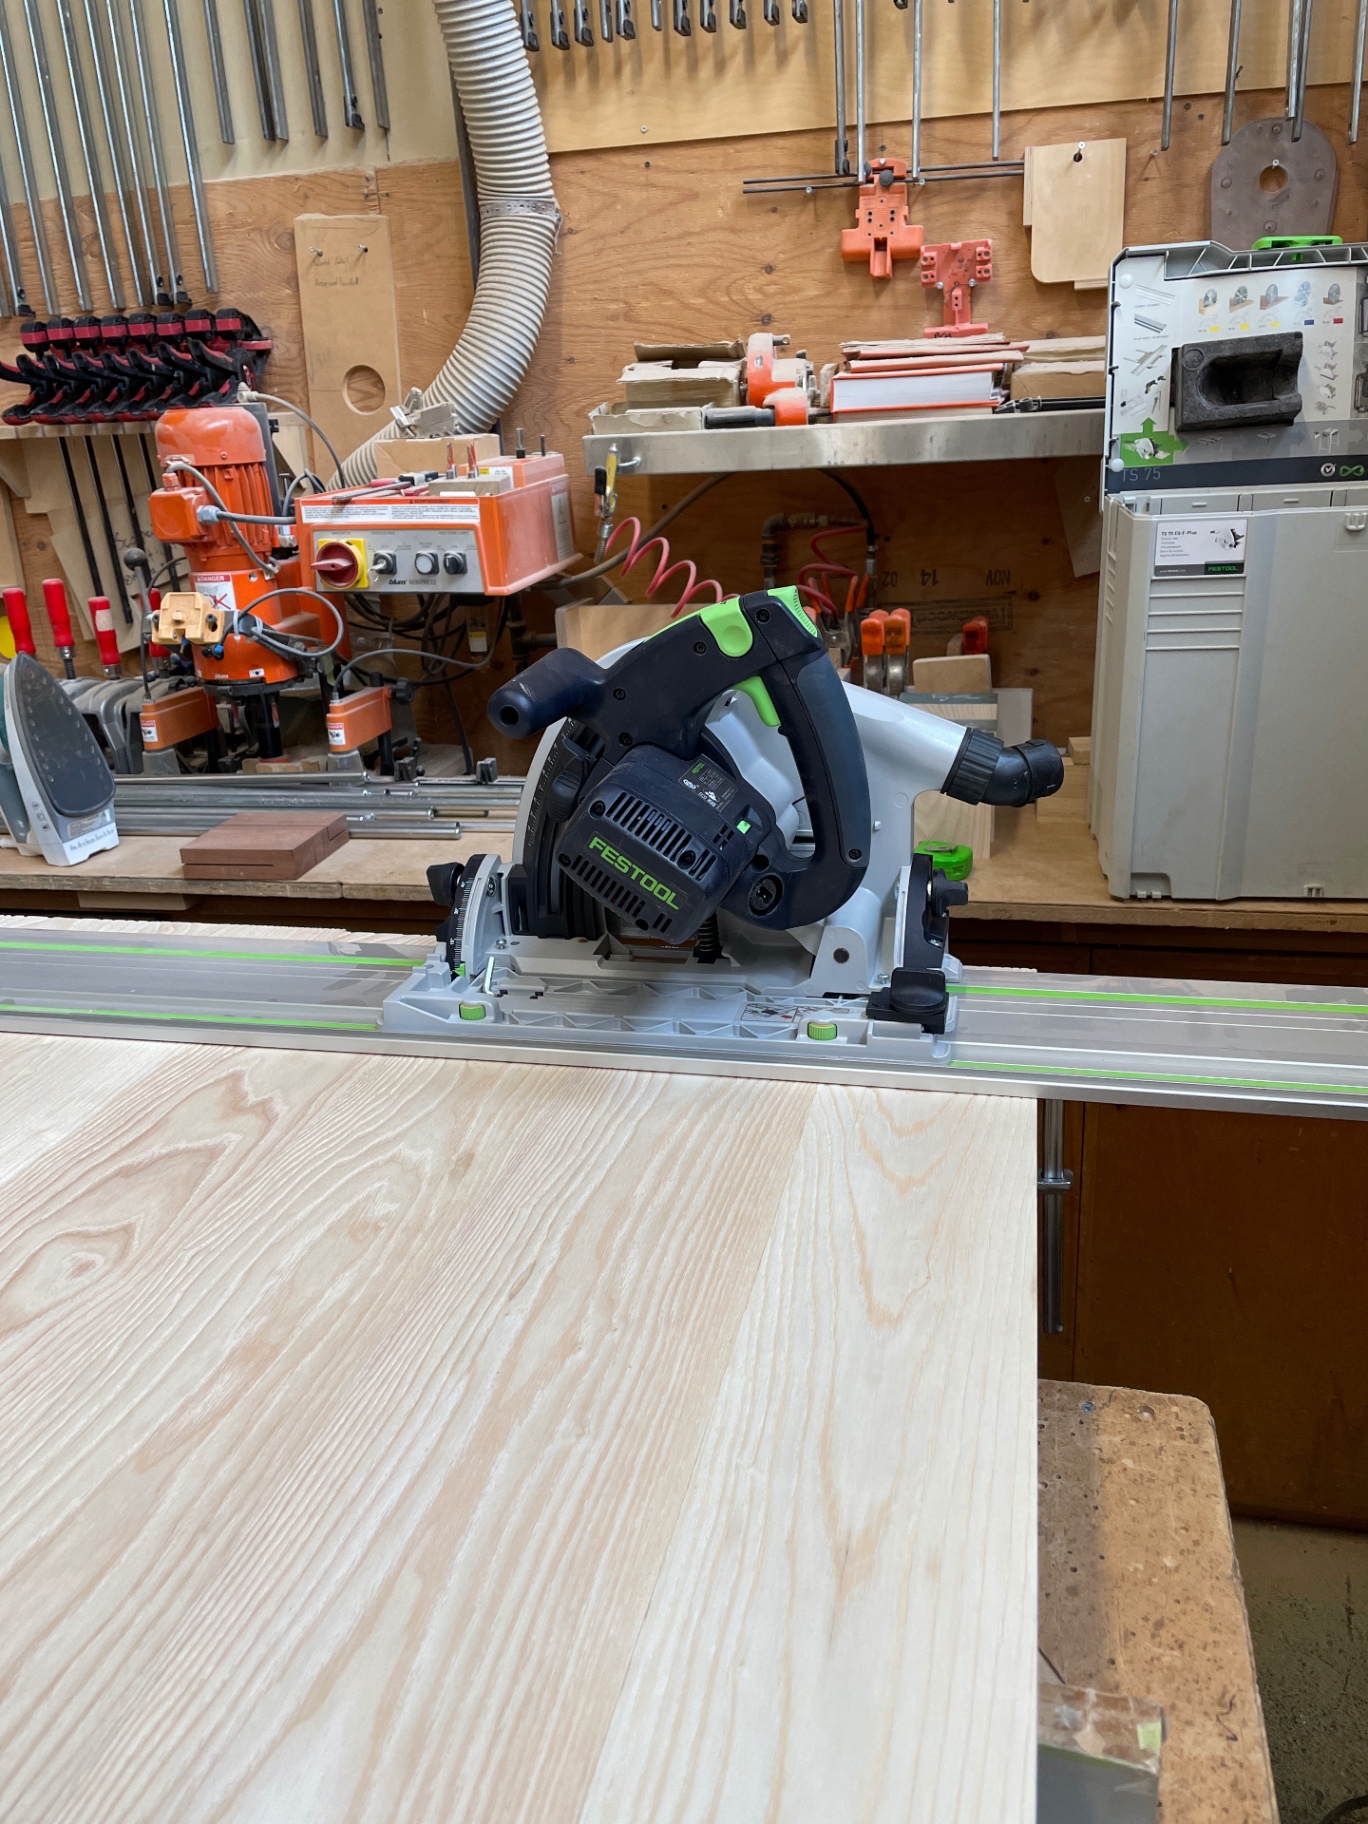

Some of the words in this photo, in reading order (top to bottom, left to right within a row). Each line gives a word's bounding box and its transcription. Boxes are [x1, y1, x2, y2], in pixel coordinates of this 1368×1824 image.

[1144, 467, 1161, 481] 75
[882, 570, 898, 588] 02
[920, 568, 938, 587] 14
[985, 569, 1011, 586] NOV
[588, 836, 679, 911] FESTOOL
